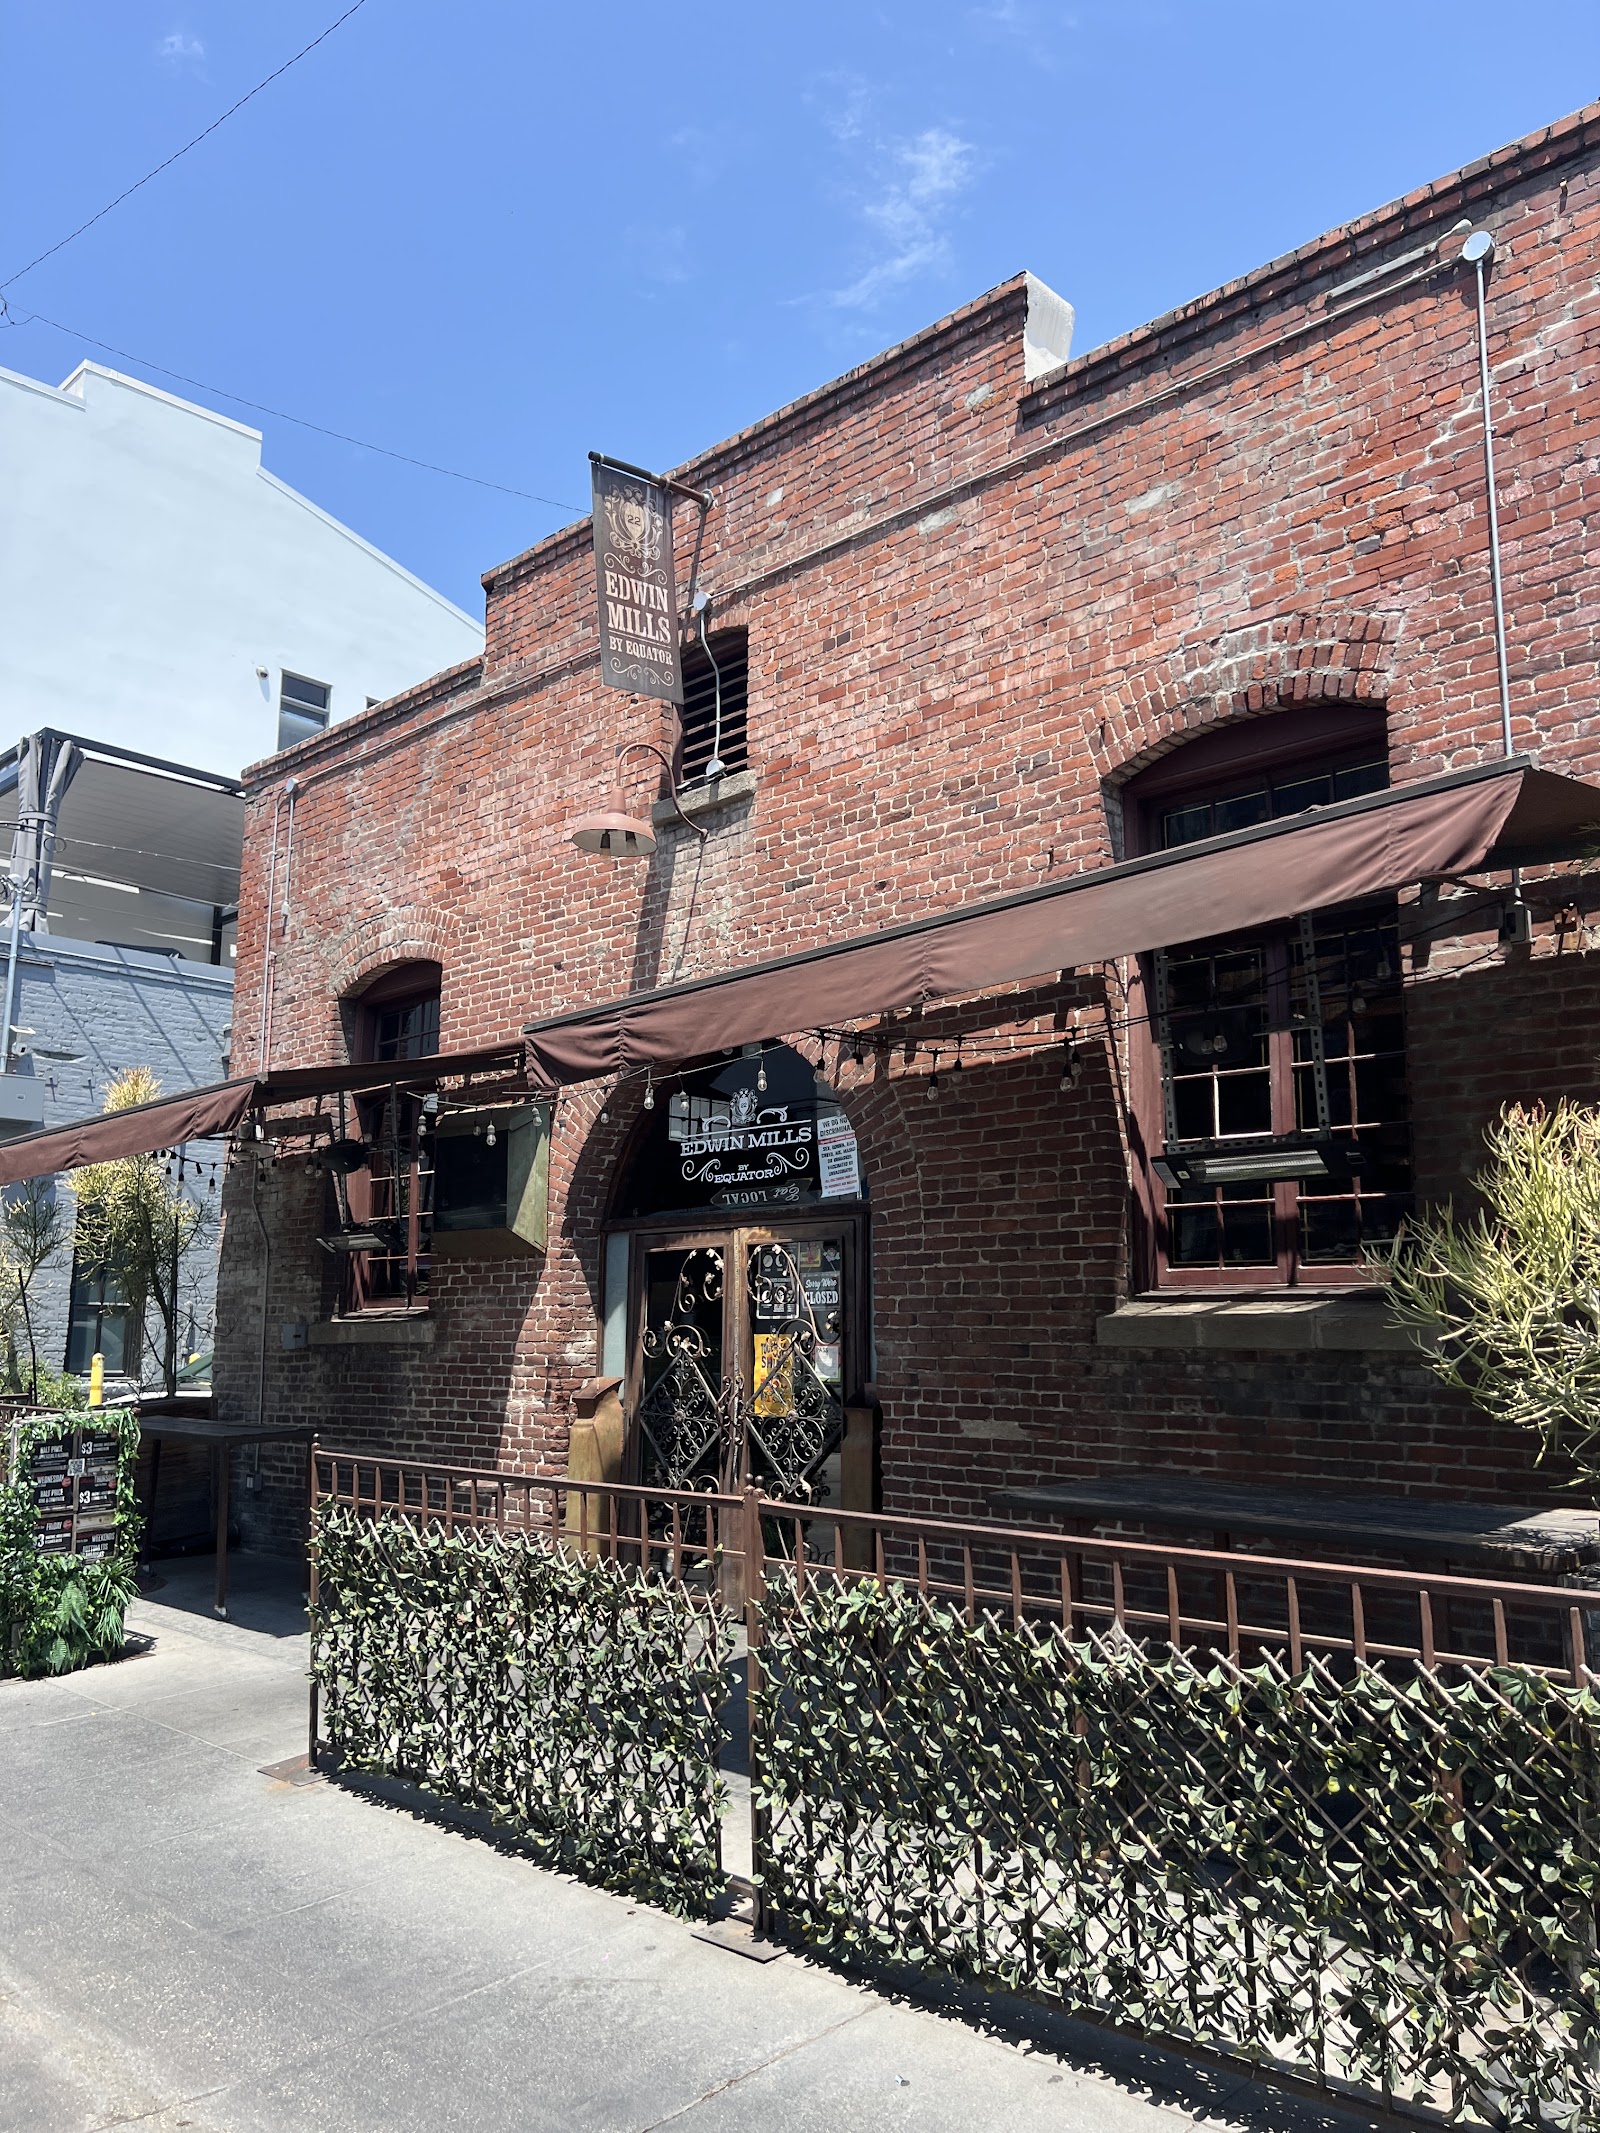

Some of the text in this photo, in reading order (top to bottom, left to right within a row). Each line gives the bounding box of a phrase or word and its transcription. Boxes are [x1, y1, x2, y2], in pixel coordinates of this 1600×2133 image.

[627, 514, 641, 526] 22
[604, 570, 669, 614] EDWIN
[605, 600, 671, 644] MILLS
[608, 635, 674, 666] BY EQUATOR
[839, 1116, 848, 1125] NO
[819, 1125, 851, 1138] DISCRIMINA
[680, 1136, 745, 1157] EDWIN
[747, 1126, 812, 1149] MILLS
[737, 1163, 750, 1171] BY
[713, 1168, 775, 1184] EQUATOR
[722, 1182, 800, 1205] Eat LOCAL
[805, 1279, 820, 1291] Sorry
[805, 1290, 839, 1305] CLOSED
[81, 1441, 93, 1455] $3
[79, 1490, 91, 1504] $3
[91, 1532, 115, 1543] WEEKENDS
